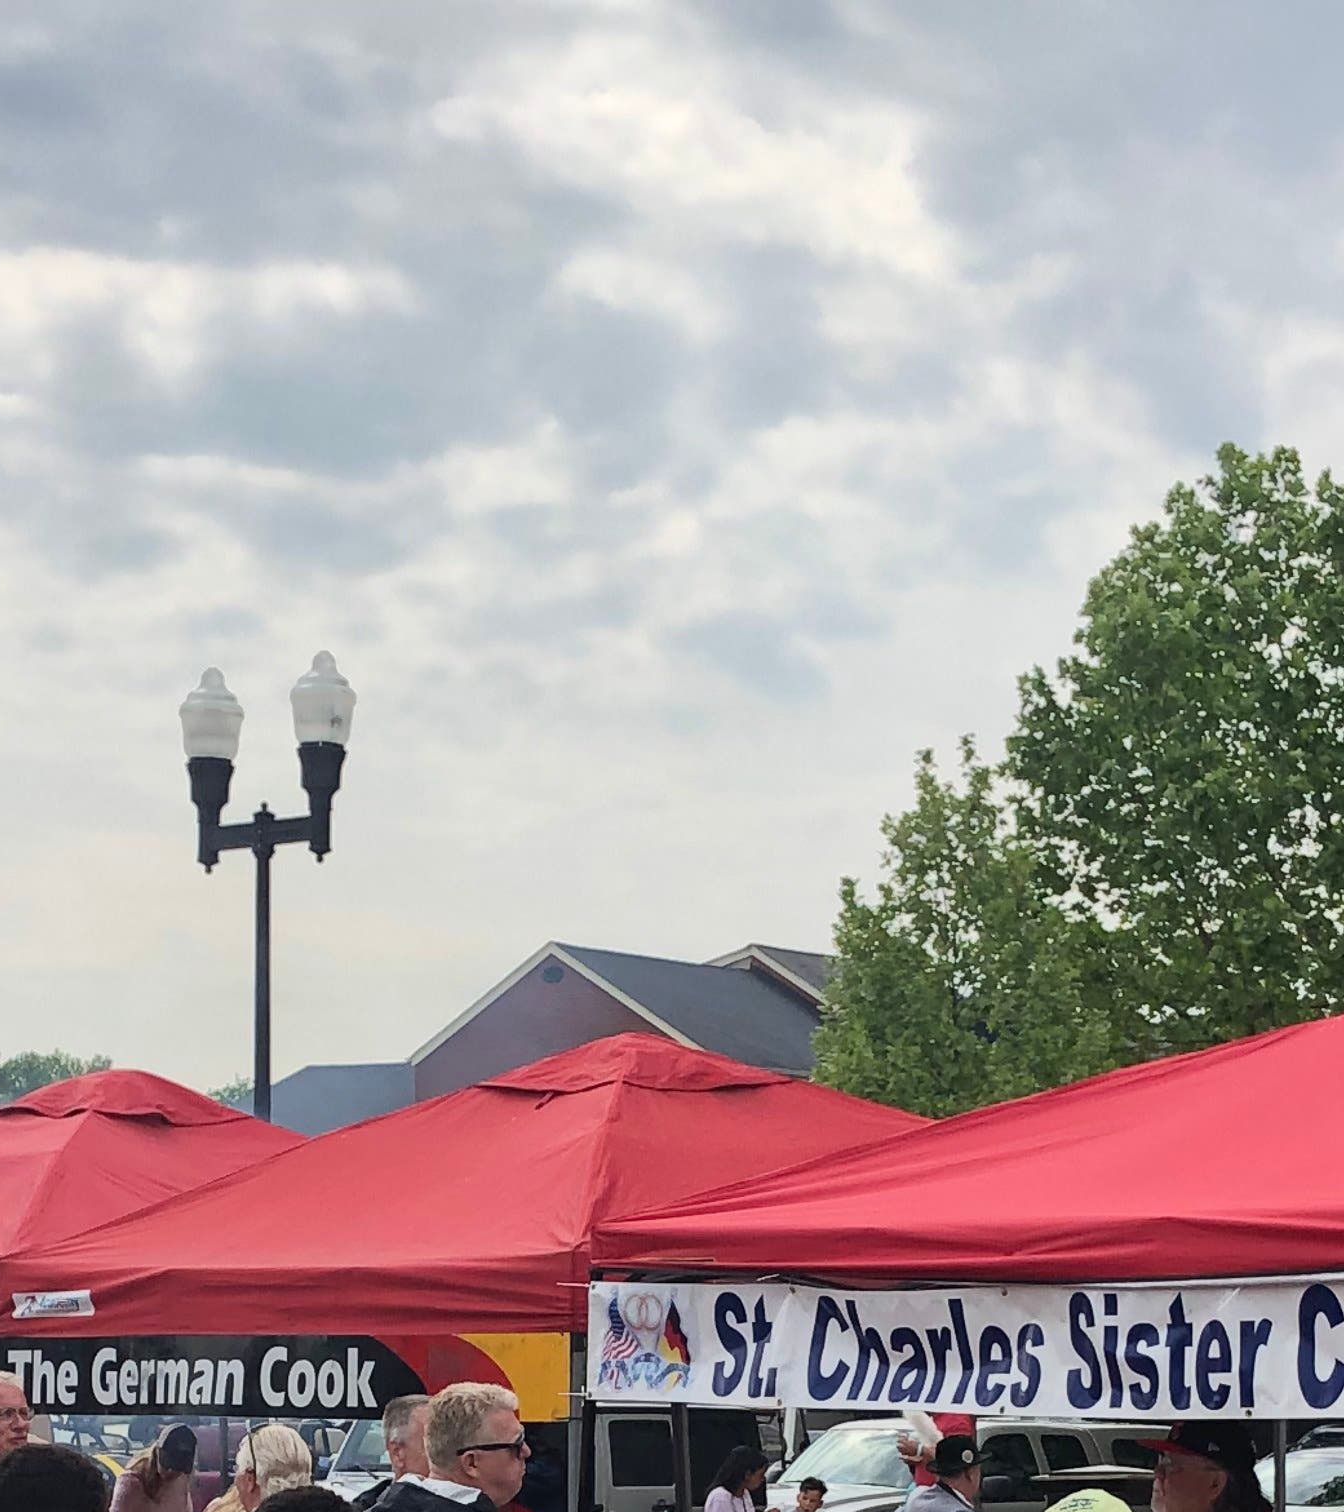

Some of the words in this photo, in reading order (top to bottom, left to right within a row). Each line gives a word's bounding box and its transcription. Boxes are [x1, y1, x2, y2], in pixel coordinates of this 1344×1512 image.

[7, 1349, 79, 1405] The
[91, 1347, 244, 1406] German
[259, 1346, 378, 1409] Cook
[711, 1291, 778, 1399] St.
[807, 1295, 1044, 1408] Charles
[1066, 1291, 1273, 1411] Sister
